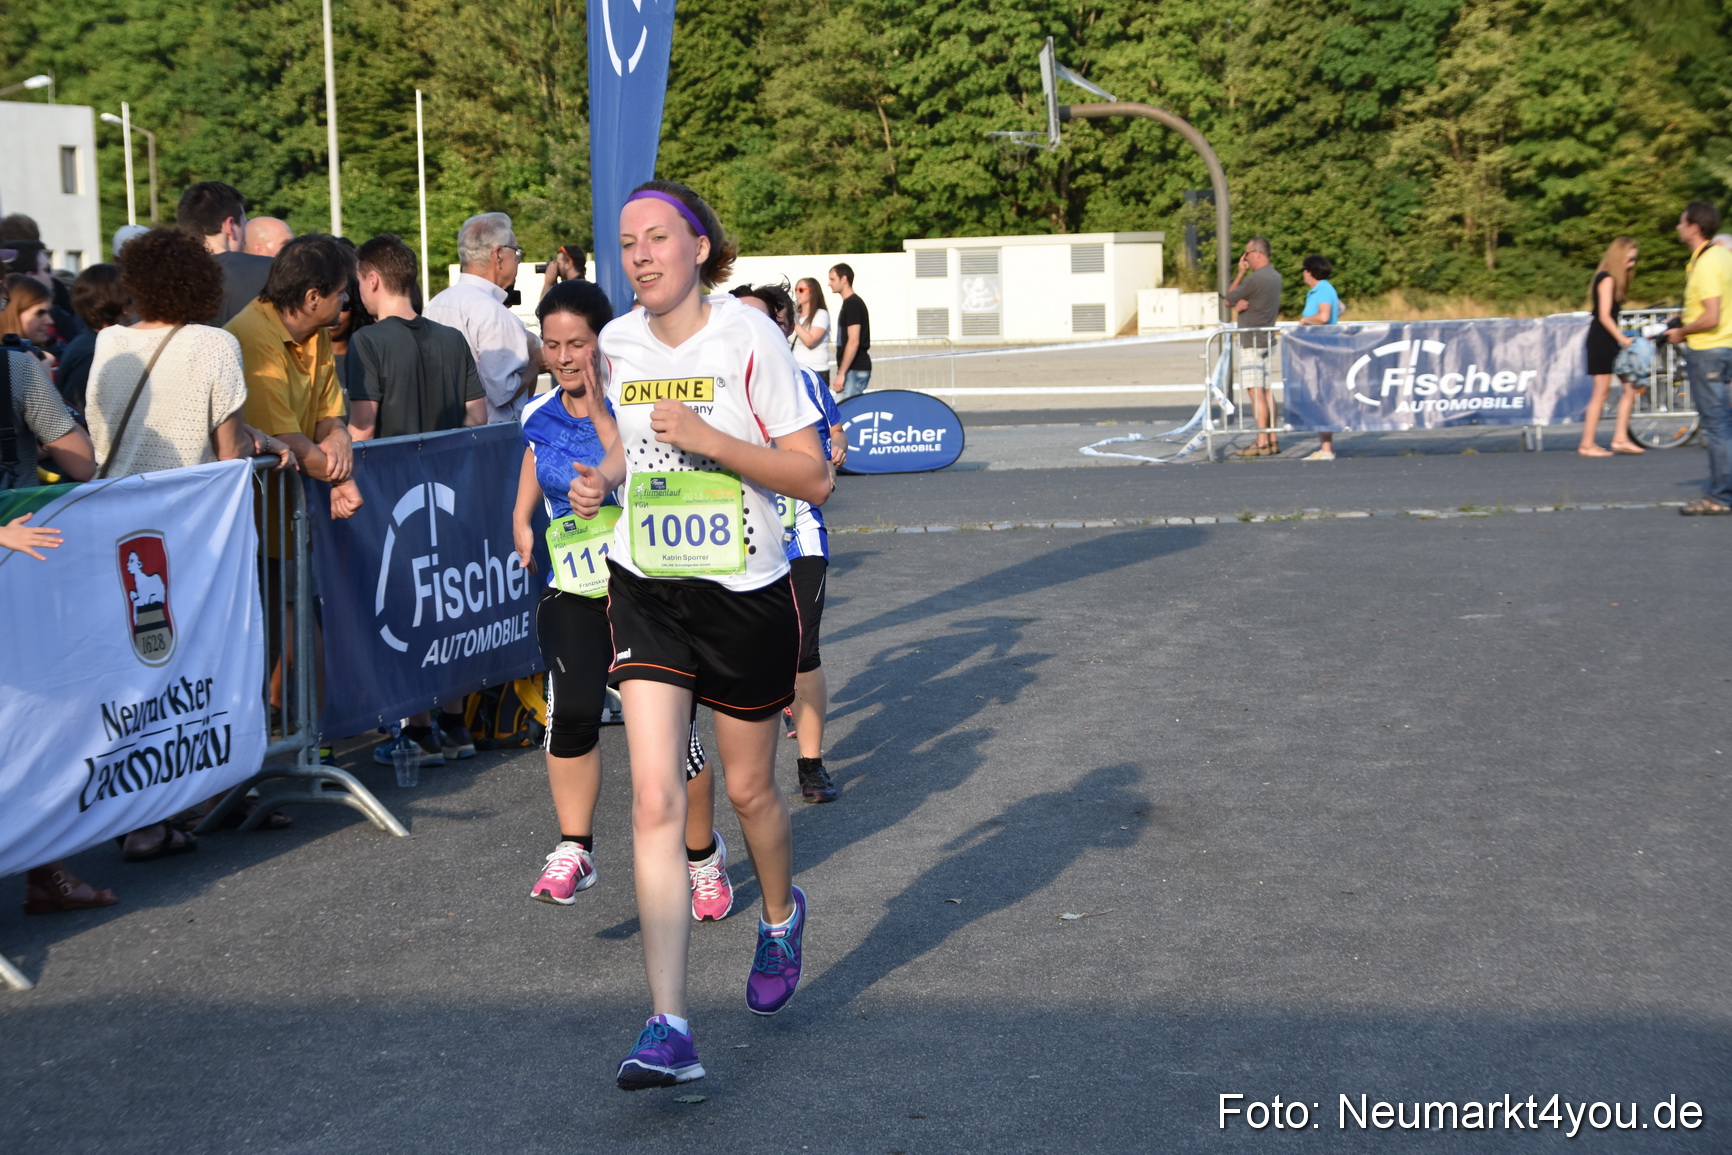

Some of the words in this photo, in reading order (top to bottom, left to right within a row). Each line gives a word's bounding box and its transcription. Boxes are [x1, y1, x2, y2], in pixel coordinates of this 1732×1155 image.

[624, 381, 704, 402] ONLINE
[1381, 365, 1537, 397] Fischer
[1395, 396, 1524, 413] AUTOMOBILE
[858, 425, 946, 446] Fischer
[869, 443, 942, 455] AUTOMOBILE
[643, 488, 682, 498] firmenlauf
[641, 513, 731, 547] 1008
[682, 553, 709, 562] Sporrer
[579, 577, 605, 588] Franziska
[142, 633, 166, 654] 1628
[421, 611, 529, 668] AUTOMOBILE
